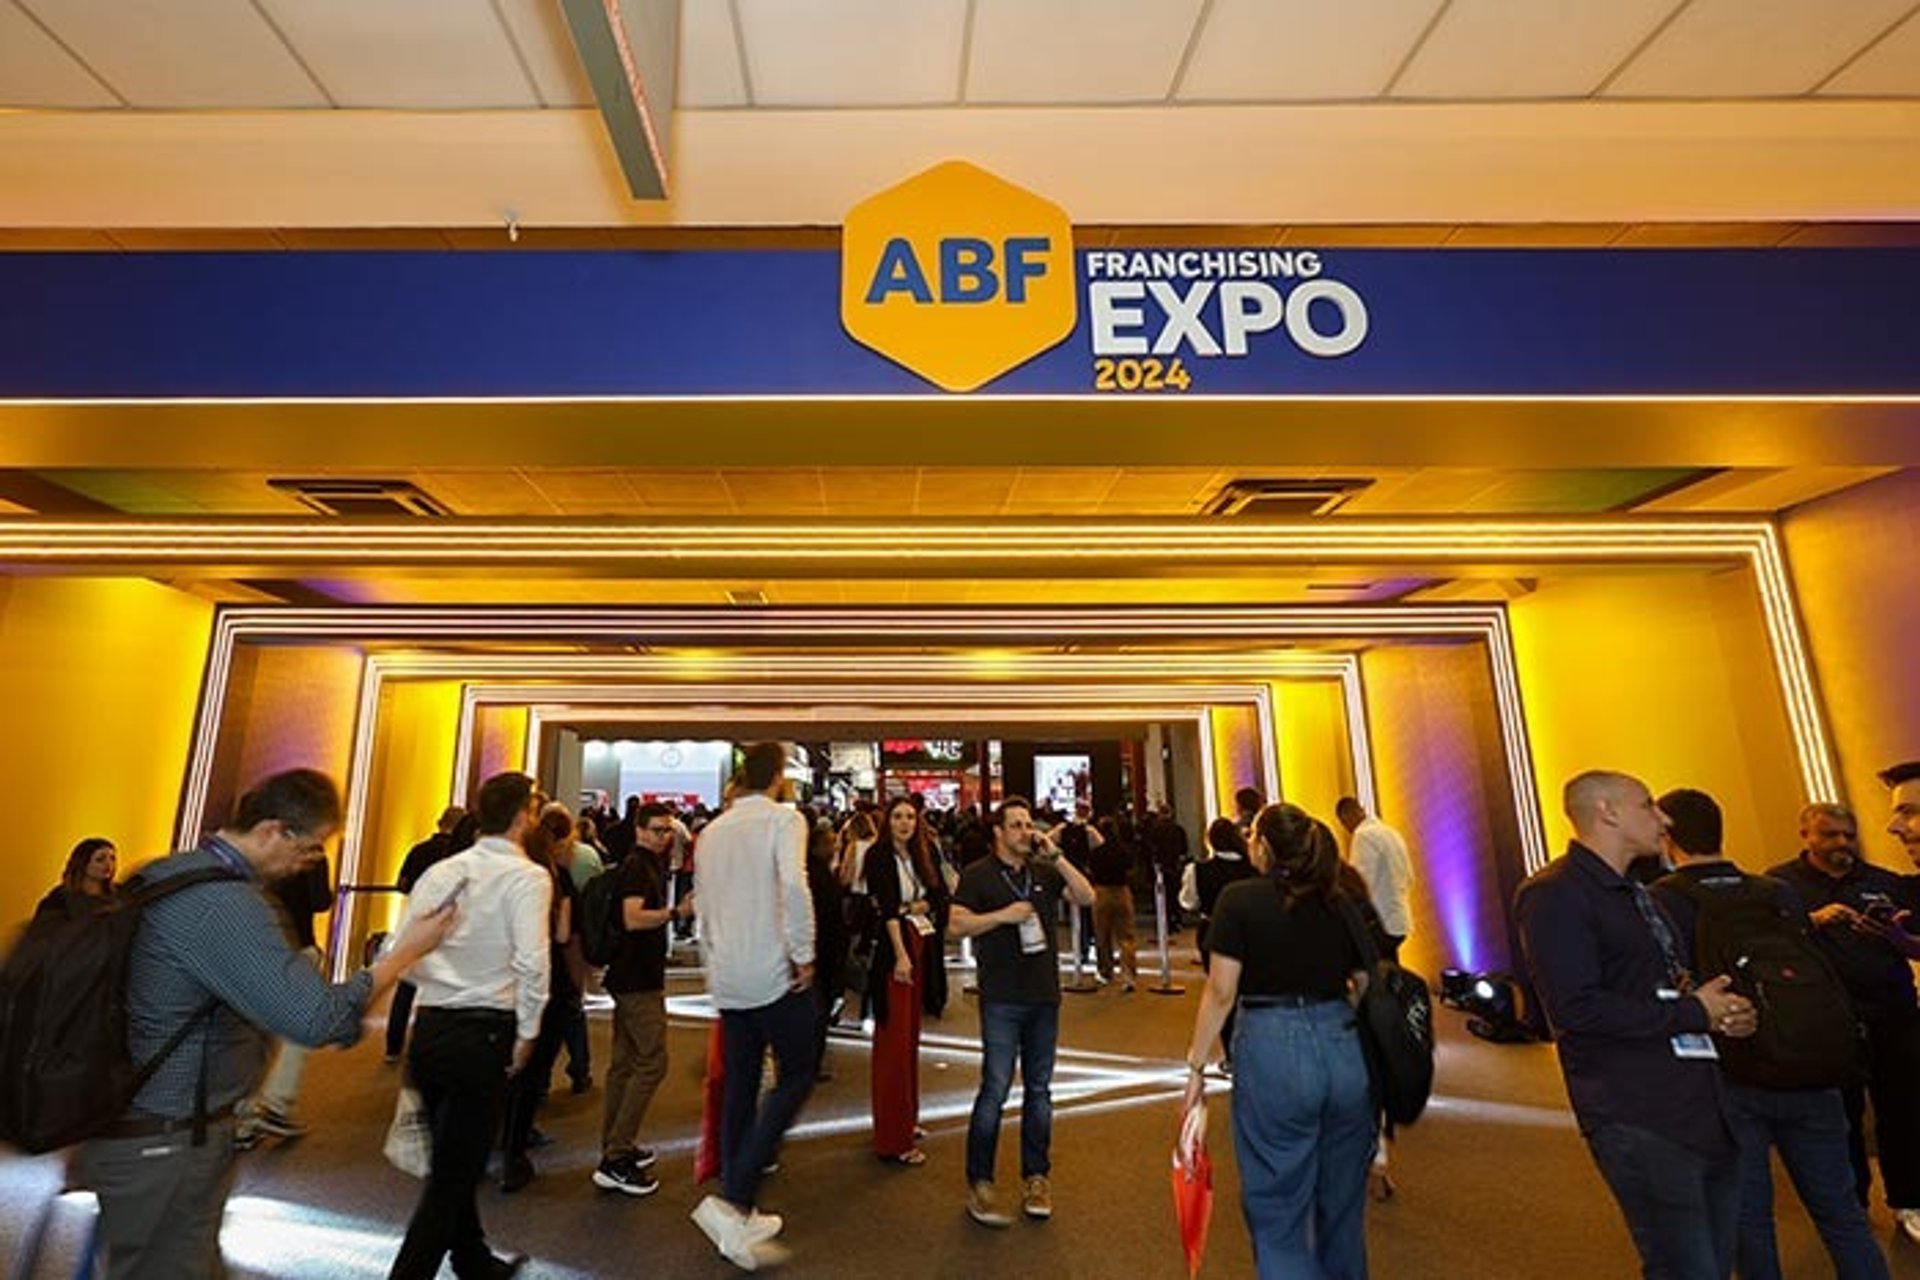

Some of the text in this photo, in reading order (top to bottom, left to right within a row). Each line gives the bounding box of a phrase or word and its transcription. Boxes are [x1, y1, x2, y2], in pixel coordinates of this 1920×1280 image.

[864, 237, 1051, 304] ABF
[1087, 251, 1322, 279] FRANCHISING
[1089, 280, 1369, 358] EXPO
[1094, 359, 1192, 391] 2024
